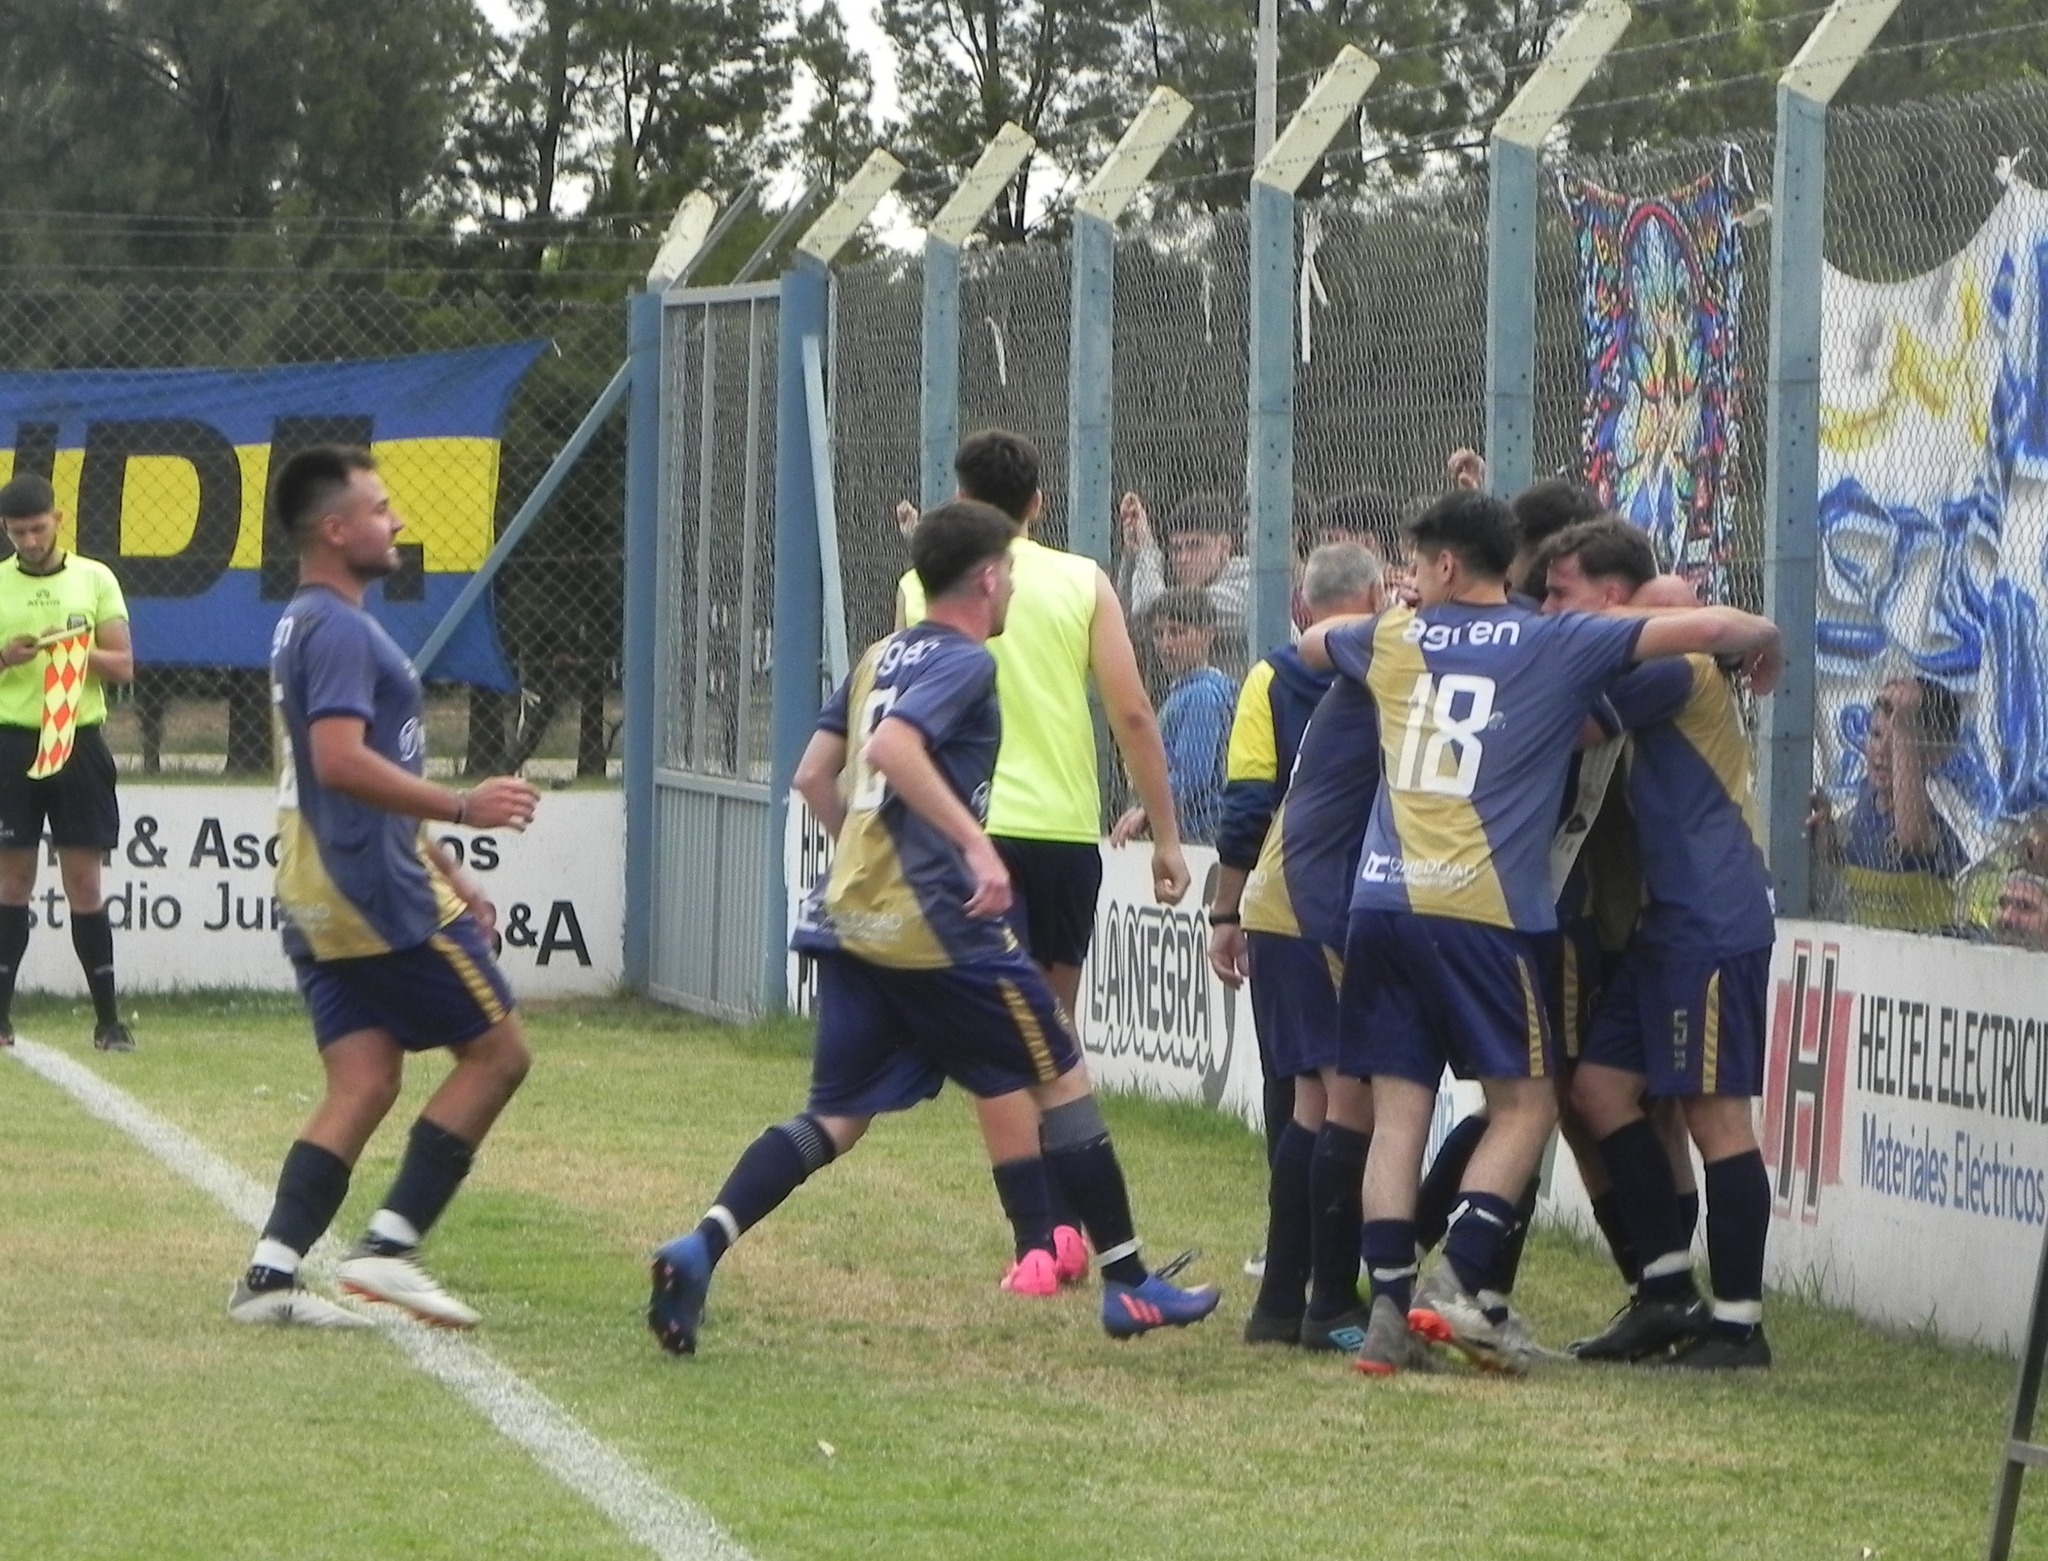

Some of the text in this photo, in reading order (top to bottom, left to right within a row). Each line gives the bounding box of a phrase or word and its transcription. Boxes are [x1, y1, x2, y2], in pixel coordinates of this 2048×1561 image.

[1396, 671, 1497, 798] 18
[126, 815, 168, 868] &
[1857, 993, 1933, 1103] HELTEL
[1861, 1111, 1948, 1208] Materiales
